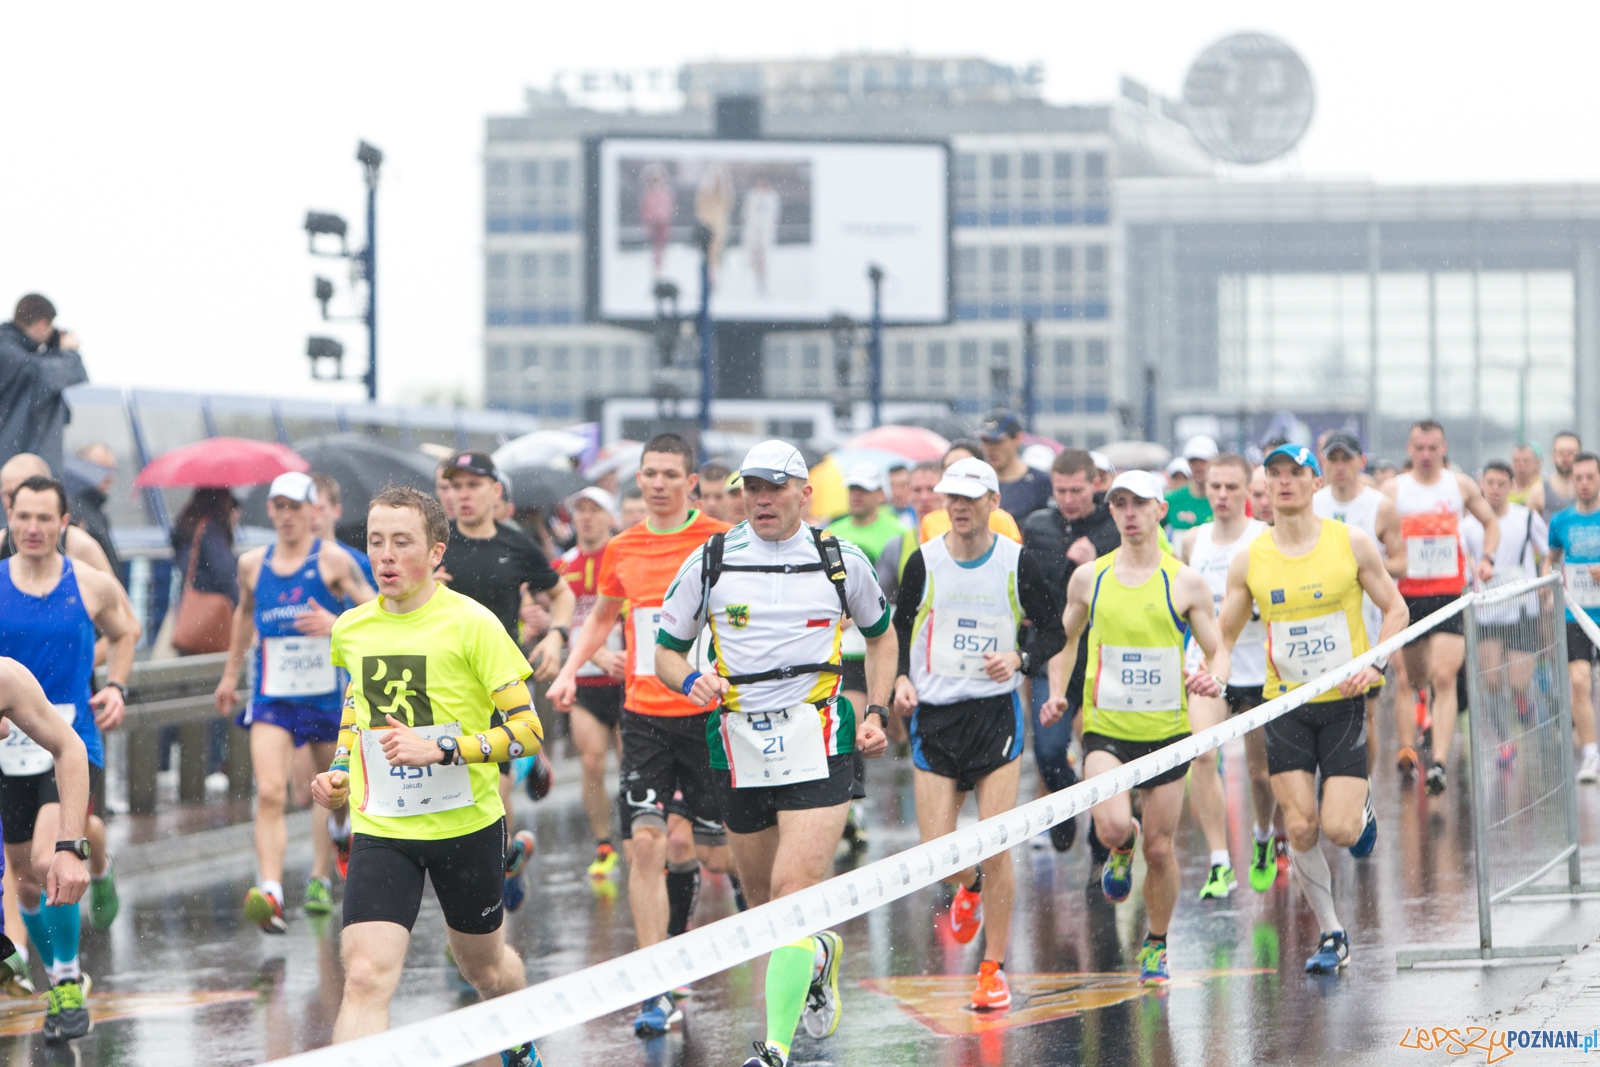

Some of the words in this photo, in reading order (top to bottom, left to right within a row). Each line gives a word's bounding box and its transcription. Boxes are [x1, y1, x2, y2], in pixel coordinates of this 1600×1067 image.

[953, 633, 998, 653] 8571
[1286, 635, 1336, 658] 7326
[1121, 668, 1161, 685] 836
[763, 735, 784, 755] 21
[402, 782, 423, 790] Jakub
